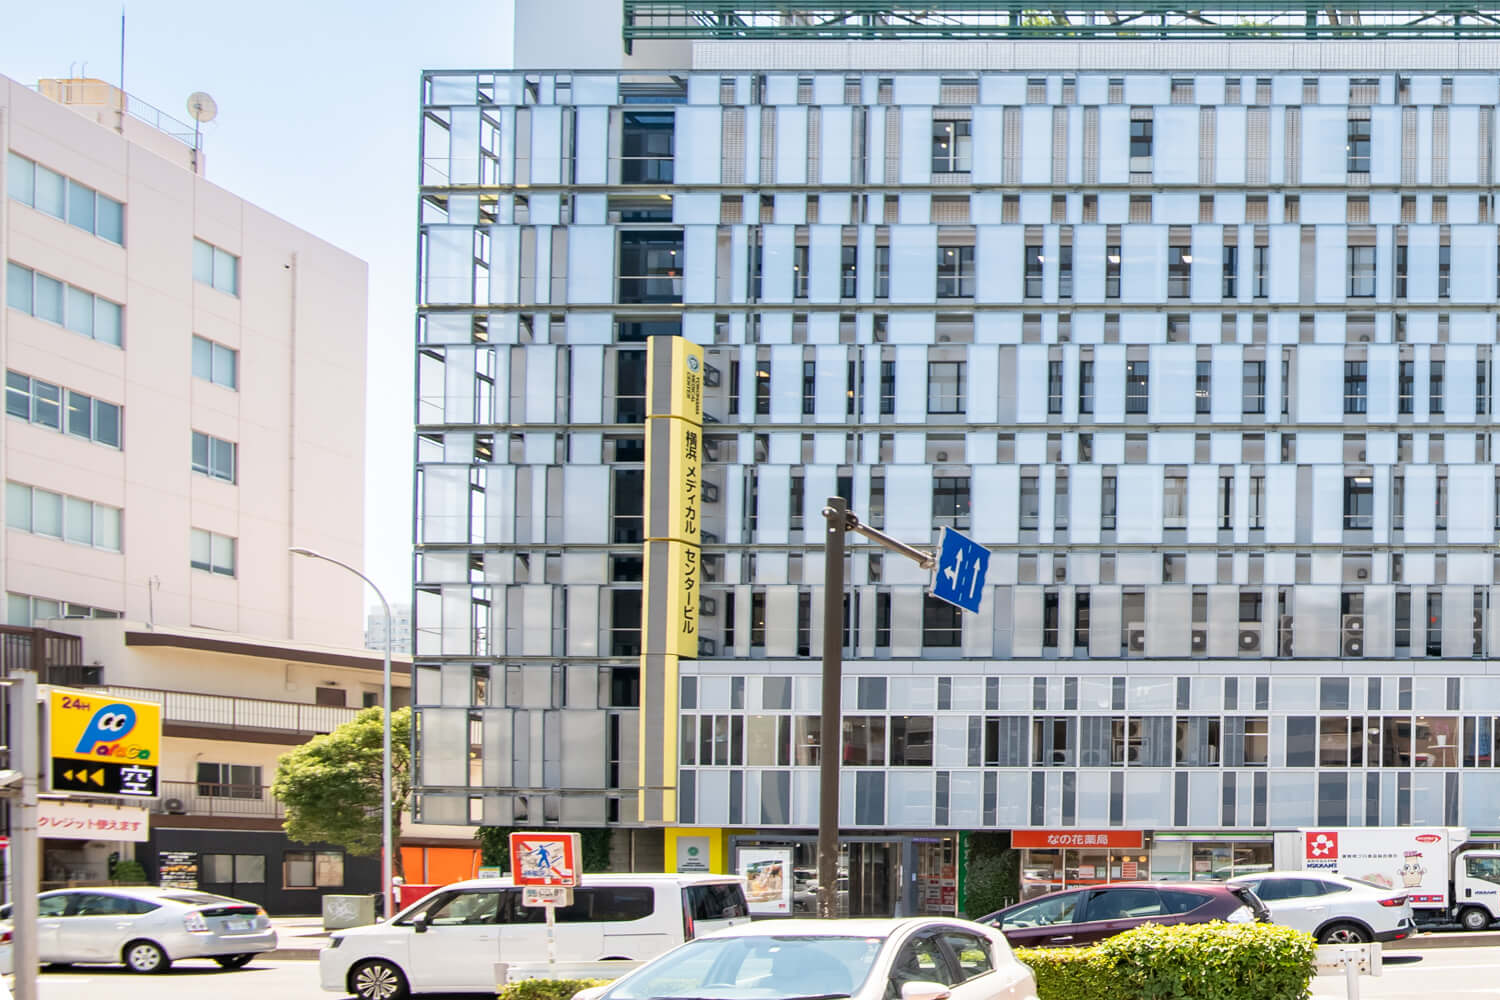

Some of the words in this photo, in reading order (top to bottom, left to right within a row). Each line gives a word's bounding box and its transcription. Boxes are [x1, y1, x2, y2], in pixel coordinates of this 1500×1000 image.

[62, 696, 90, 711] 24H
[119, 765, 153, 795] 空
[1047, 834, 1109, 845] なの花薬局
